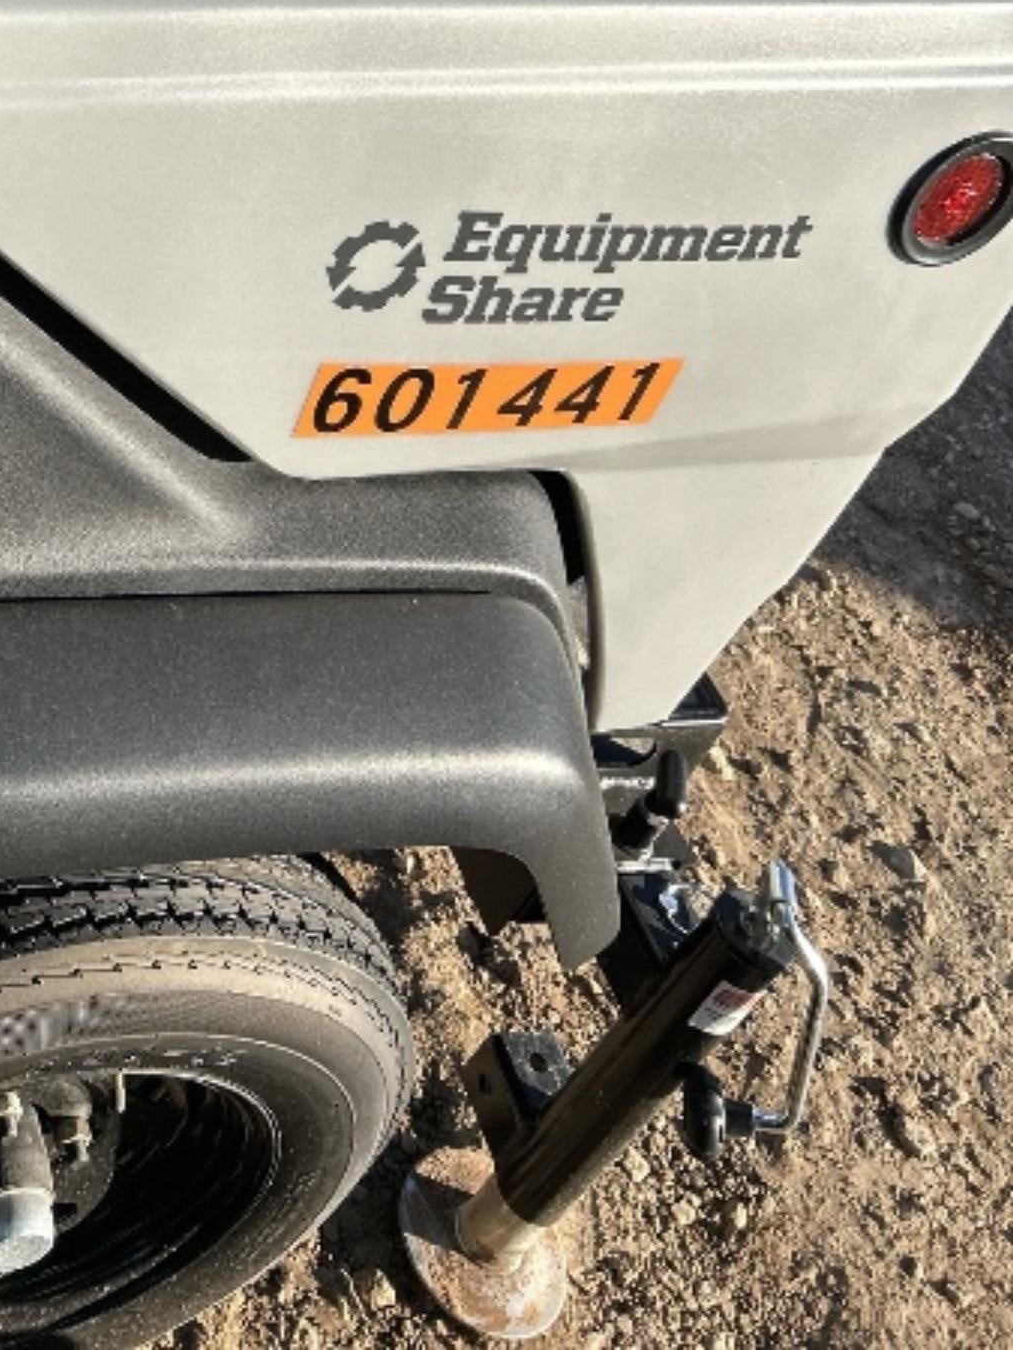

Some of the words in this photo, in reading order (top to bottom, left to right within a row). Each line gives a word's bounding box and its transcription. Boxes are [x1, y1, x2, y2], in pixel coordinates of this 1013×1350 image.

[443, 211, 813, 274] Equipment
[422, 276, 624, 324] Share
[313, 362, 660, 433] 601441
